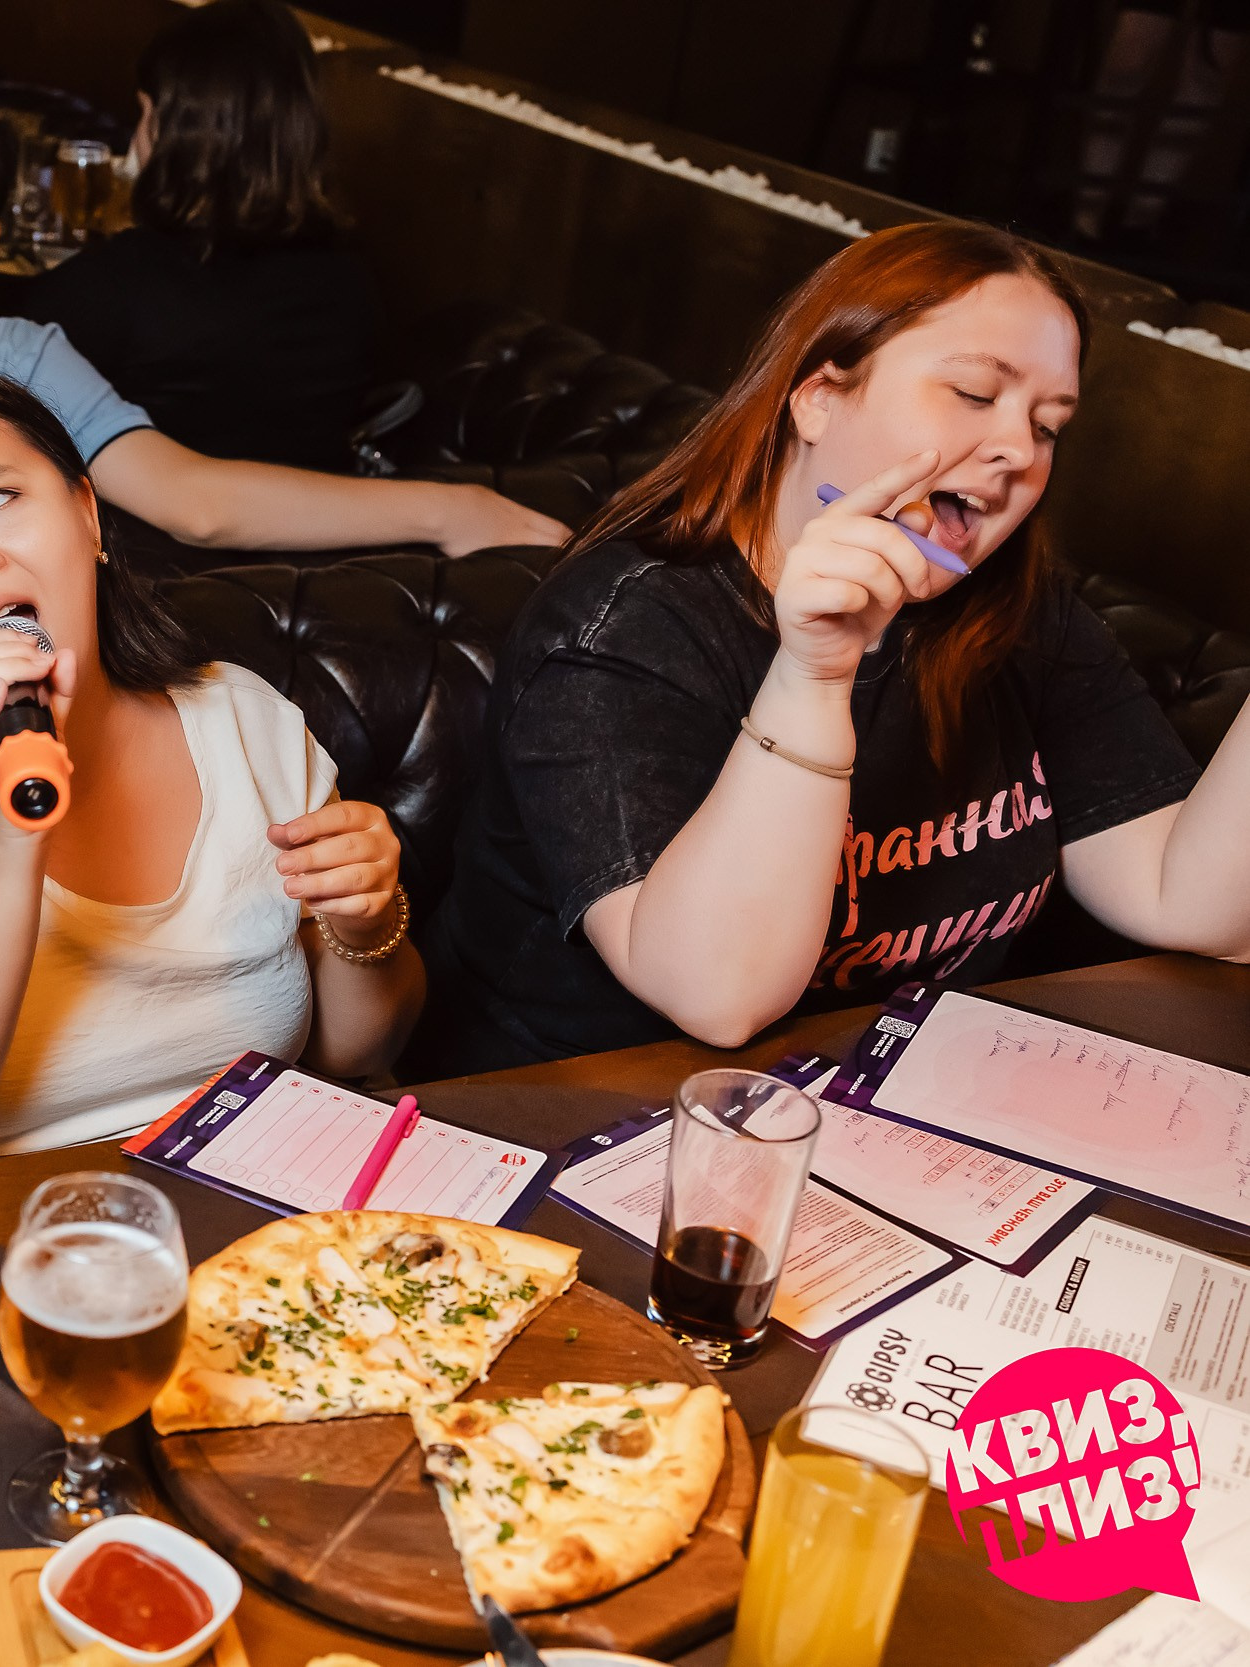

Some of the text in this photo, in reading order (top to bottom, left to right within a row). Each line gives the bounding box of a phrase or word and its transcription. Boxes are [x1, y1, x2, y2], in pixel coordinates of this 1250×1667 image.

[984, 1177, 1067, 1247] ЭТО ВАШ ЧЕРНОВИК
[1058, 1287, 1075, 1310] COGNAC
[1071, 1259, 1087, 1283] BRANDY
[1164, 1301, 1182, 1333] COCKTAILS
[865, 1326, 911, 1383] GIPSY
[902, 1353, 984, 1431] BAR
